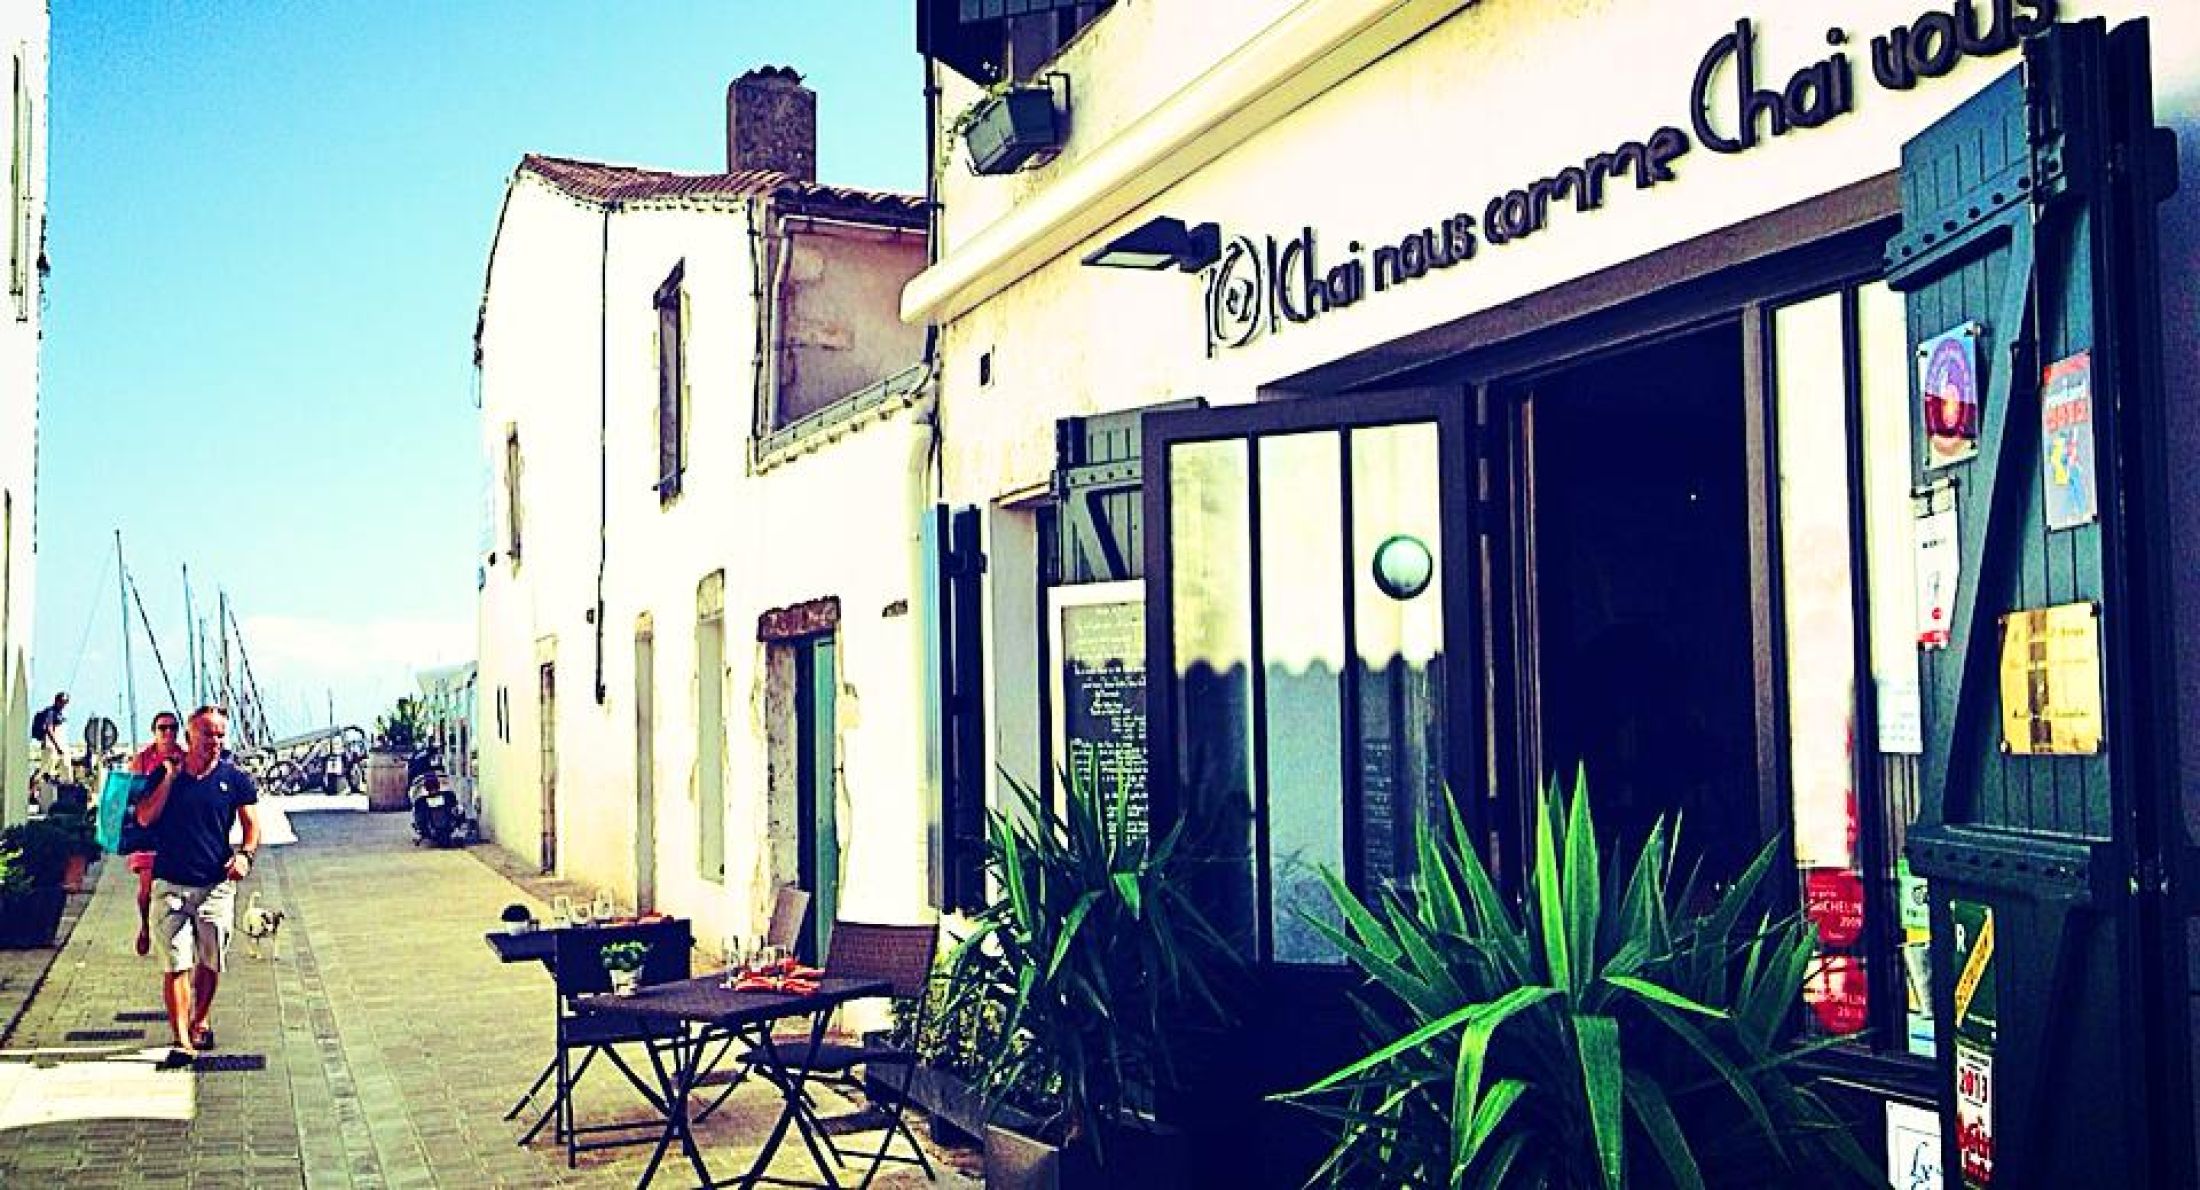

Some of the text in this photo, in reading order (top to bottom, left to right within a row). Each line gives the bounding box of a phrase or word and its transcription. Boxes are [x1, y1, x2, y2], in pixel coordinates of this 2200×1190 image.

[1278, 226, 1366, 323] Chai
[1373, 213, 1478, 292] nous
[1484, 125, 1691, 245] comme
[1691, 16, 1855, 154] Chai
